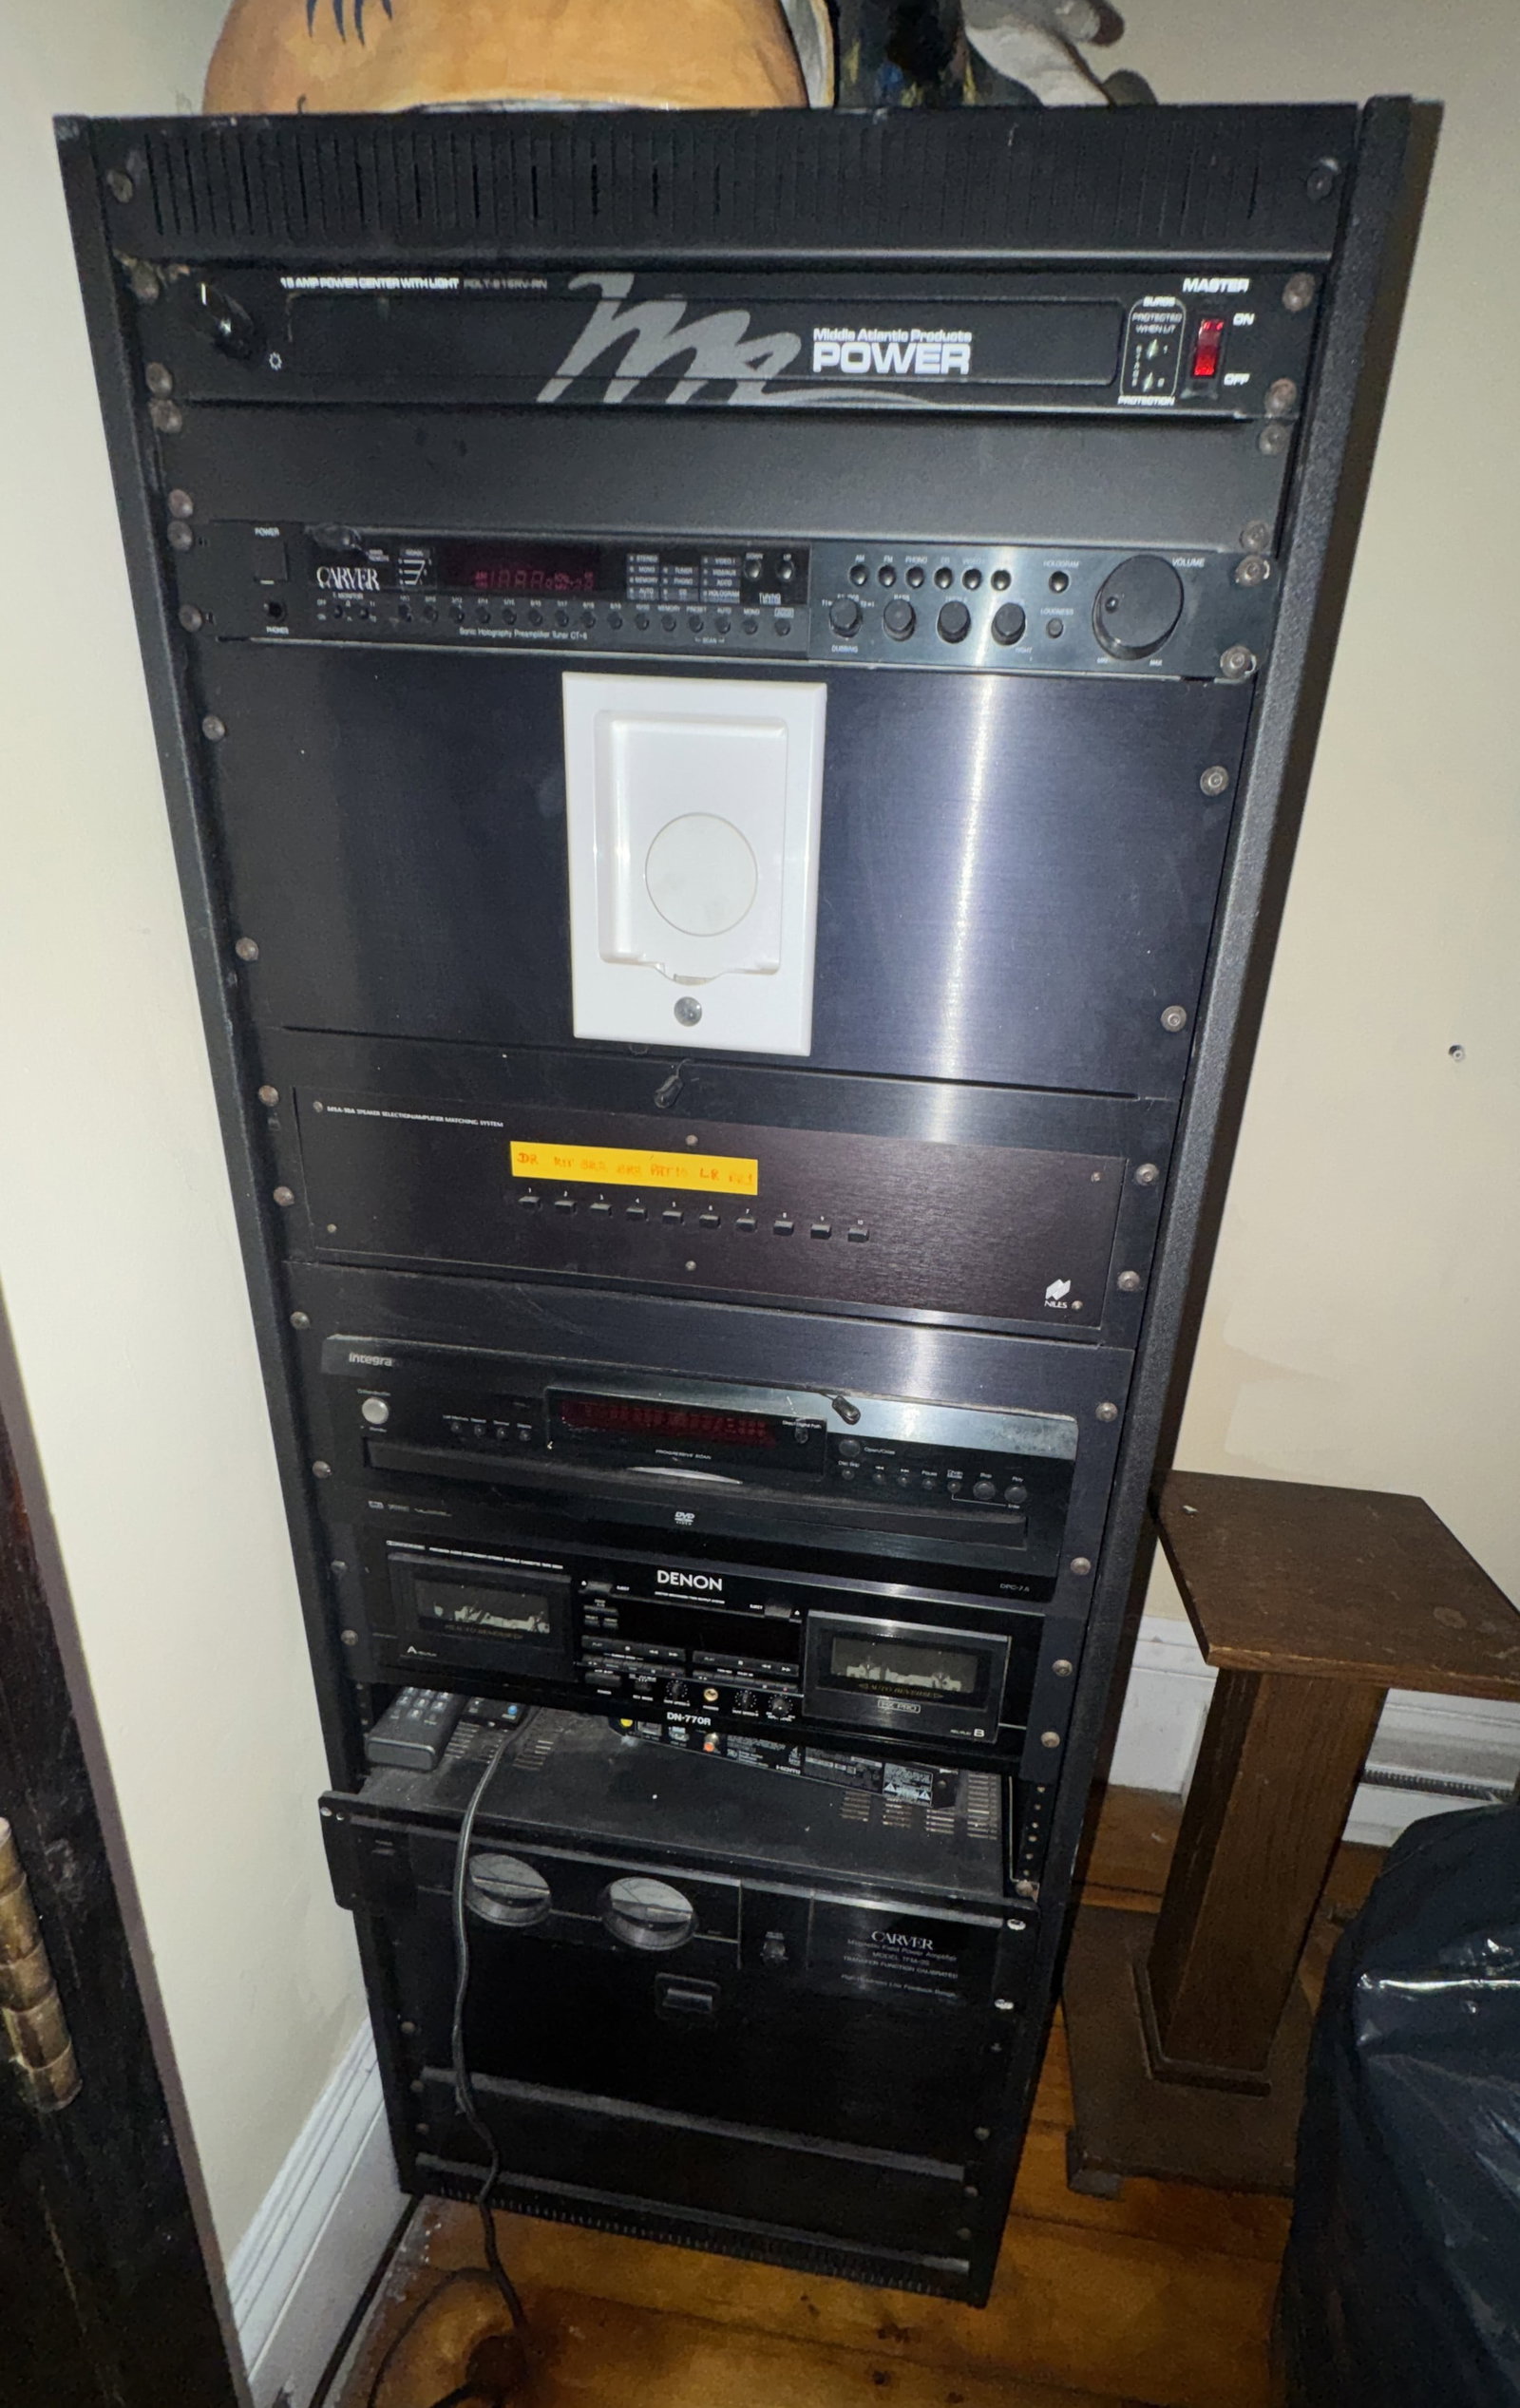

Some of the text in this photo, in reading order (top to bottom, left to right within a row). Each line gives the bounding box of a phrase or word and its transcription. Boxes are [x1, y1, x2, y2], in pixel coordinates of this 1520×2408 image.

[295, 276, 319, 289] AMP
[319, 276, 359, 289] POWER
[359, 277, 400, 289] CENTER
[400, 277, 428, 289] WITH
[428, 277, 459, 289] LIGHT
[1182, 277, 1250, 294] MASTER
[1131, 313, 1183, 323] PROTECTED
[1232, 313, 1255, 326] ON
[813, 328, 972, 342] Middle Atlantic Products
[813, 341, 971, 374] POWER
[1224, 373, 1250, 386] OFF
[1117, 395, 1175, 407] PROTECTION
[255, 527, 280, 537] POWER
[1044, 559, 1079, 568] HOLOGRAM
[1172, 558, 1206, 567] VOLUME
[316, 566, 380, 591] CARVER
[459, 627, 477, 636] Sonic
[478, 628, 512, 638] Holography
[514, 630, 550, 638] Preamplifier
[552, 630, 568, 639] Tuner
[831, 645, 858, 654] DUBBING
[480, 1120, 504, 1128] SYSTEM
[1044, 1299, 1068, 1309] NILES
[349, 1352, 392, 1367] Integra
[674, 1511, 695, 1520] DVD
[656, 1569, 723, 1592] DENON
[666, 1712, 712, 1727] DN-770R
[974, 1728, 985, 1737] B
[871, 1930, 934, 1951] CARVER
